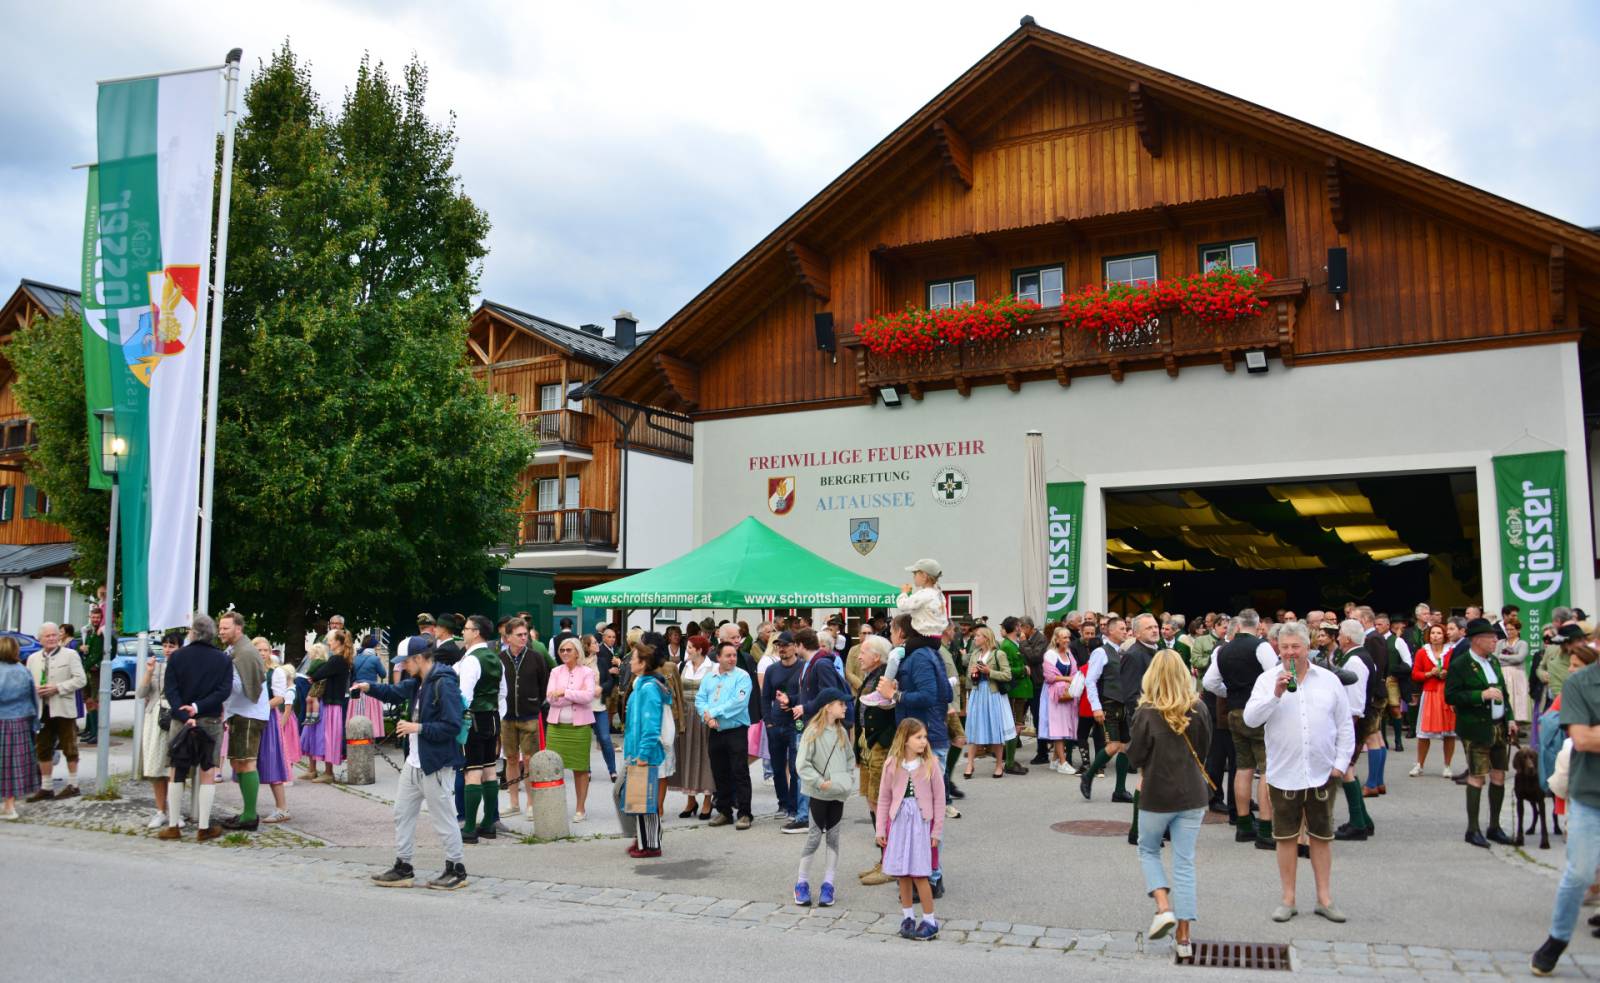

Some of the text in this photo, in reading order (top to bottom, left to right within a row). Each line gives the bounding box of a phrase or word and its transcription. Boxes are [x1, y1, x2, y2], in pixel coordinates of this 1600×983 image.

[749, 440, 985, 471] FREIWILLIGE FEUERWEHR
[820, 471, 910, 487] BERGRETTUNG
[816, 492, 916, 511] ALTAUSSEE
[1510, 480, 1563, 602] Gösser
[584, 592, 712, 604] www.schrottshammer.at
[744, 592, 896, 605] www.schrottshammer.at
